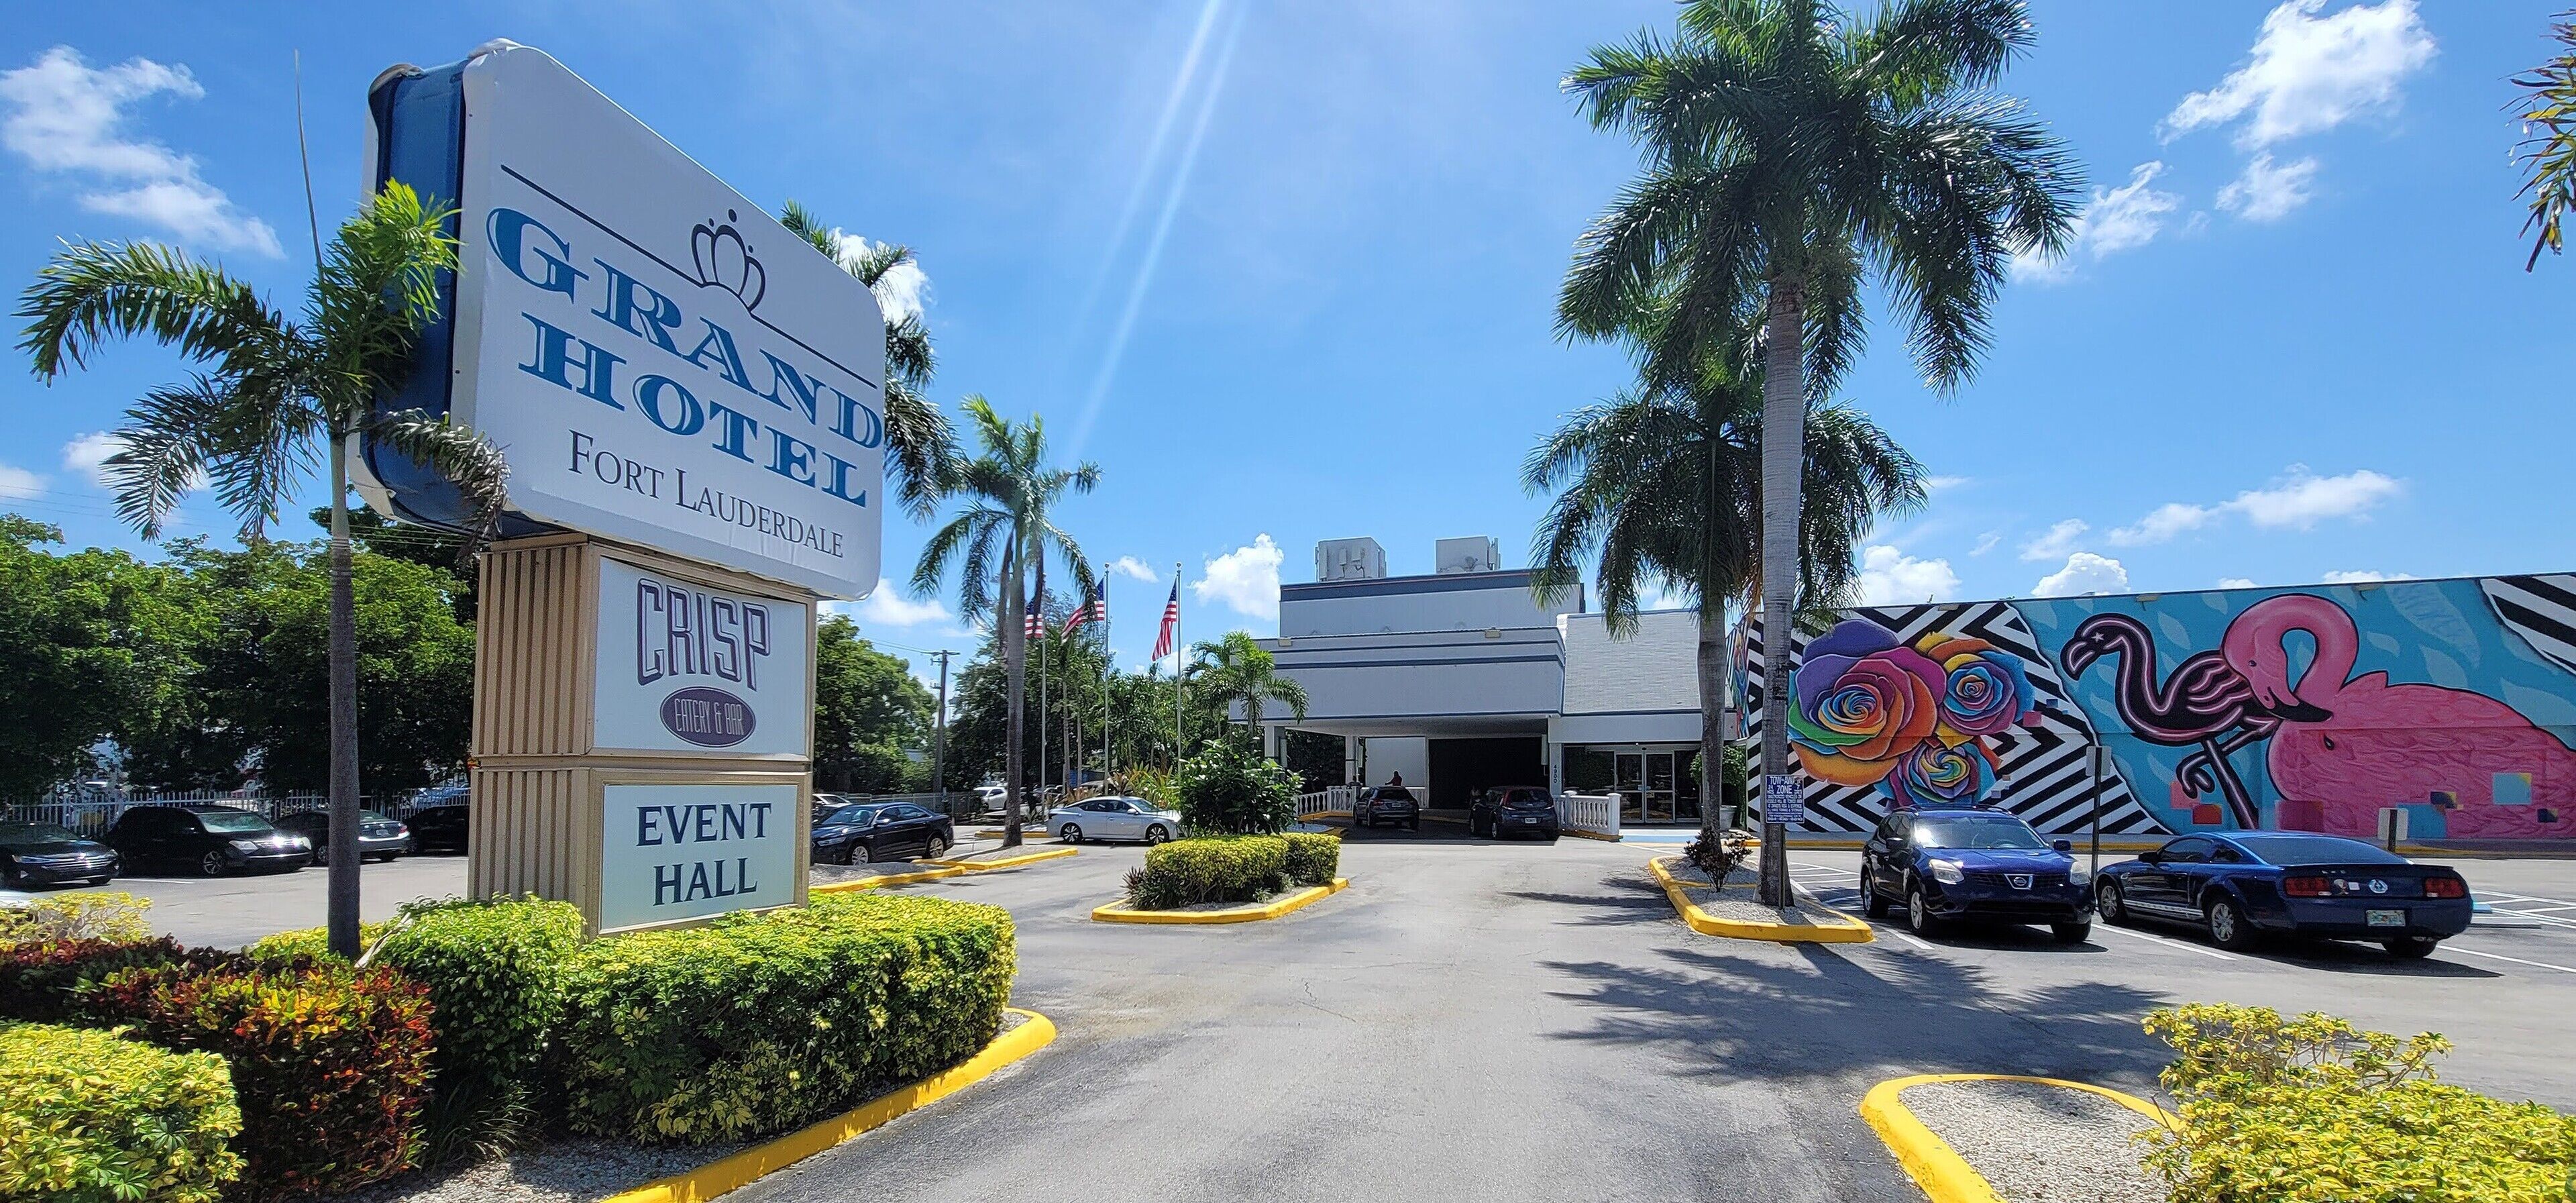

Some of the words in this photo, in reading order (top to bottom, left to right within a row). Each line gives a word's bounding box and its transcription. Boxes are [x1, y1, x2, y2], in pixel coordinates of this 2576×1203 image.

[486, 208, 882, 449] GRAND
[519, 312, 867, 508] HOTEL
[568, 429, 664, 499] FORT
[676, 468, 843, 559] LAUDERDALE
[637, 578, 771, 691] CRISP
[674, 698, 711, 733] EATERY
[714, 702, 722, 734] &
[724, 702, 744, 735] BAR
[636, 803, 771, 847] EVENT
[1776, 784, 1792, 794] ZONE
[653, 857, 758, 906] HALL
